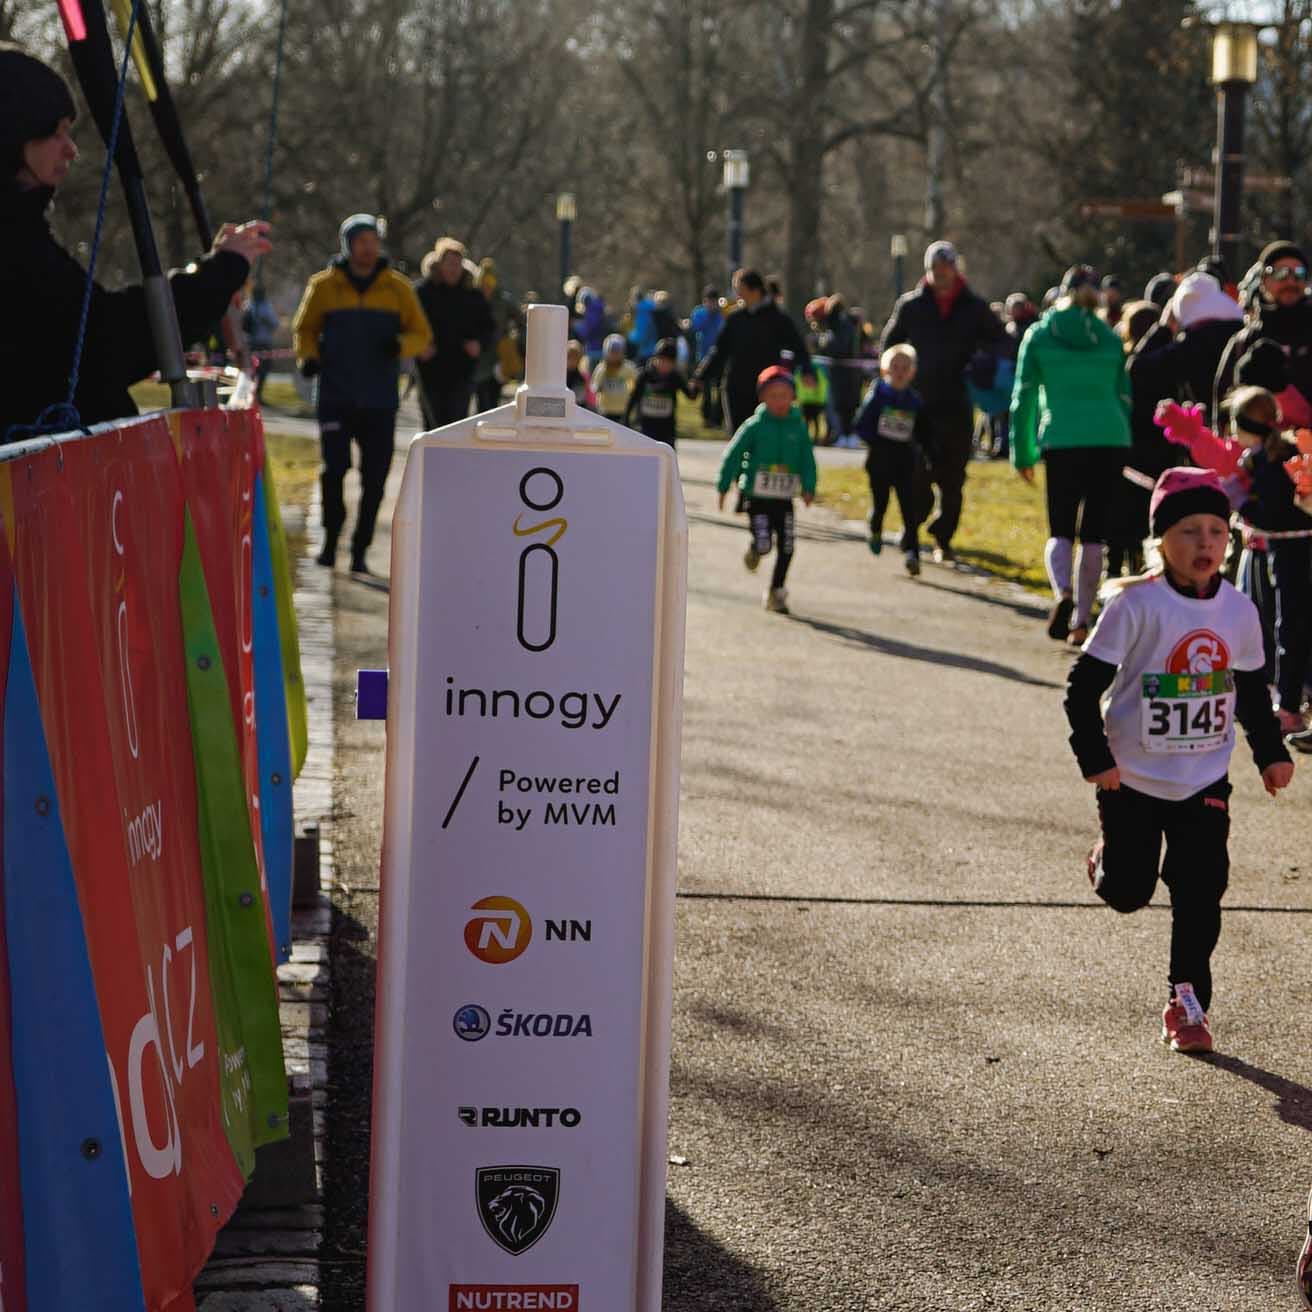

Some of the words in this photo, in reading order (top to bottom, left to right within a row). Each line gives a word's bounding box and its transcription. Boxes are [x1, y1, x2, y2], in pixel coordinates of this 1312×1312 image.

[445, 676, 622, 729] innogy
[1148, 698, 1227, 735] 3145
[499, 770, 620, 795] Powered
[498, 800, 531, 830] by
[543, 803, 617, 826] MVM
[544, 919, 592, 942] NN
[495, 1008, 593, 1037] ŠKODA
[481, 1107, 581, 1128] RUNTO
[483, 1172, 552, 1183] PEUGEOT
[456, 1291, 573, 1310] NUTREND
